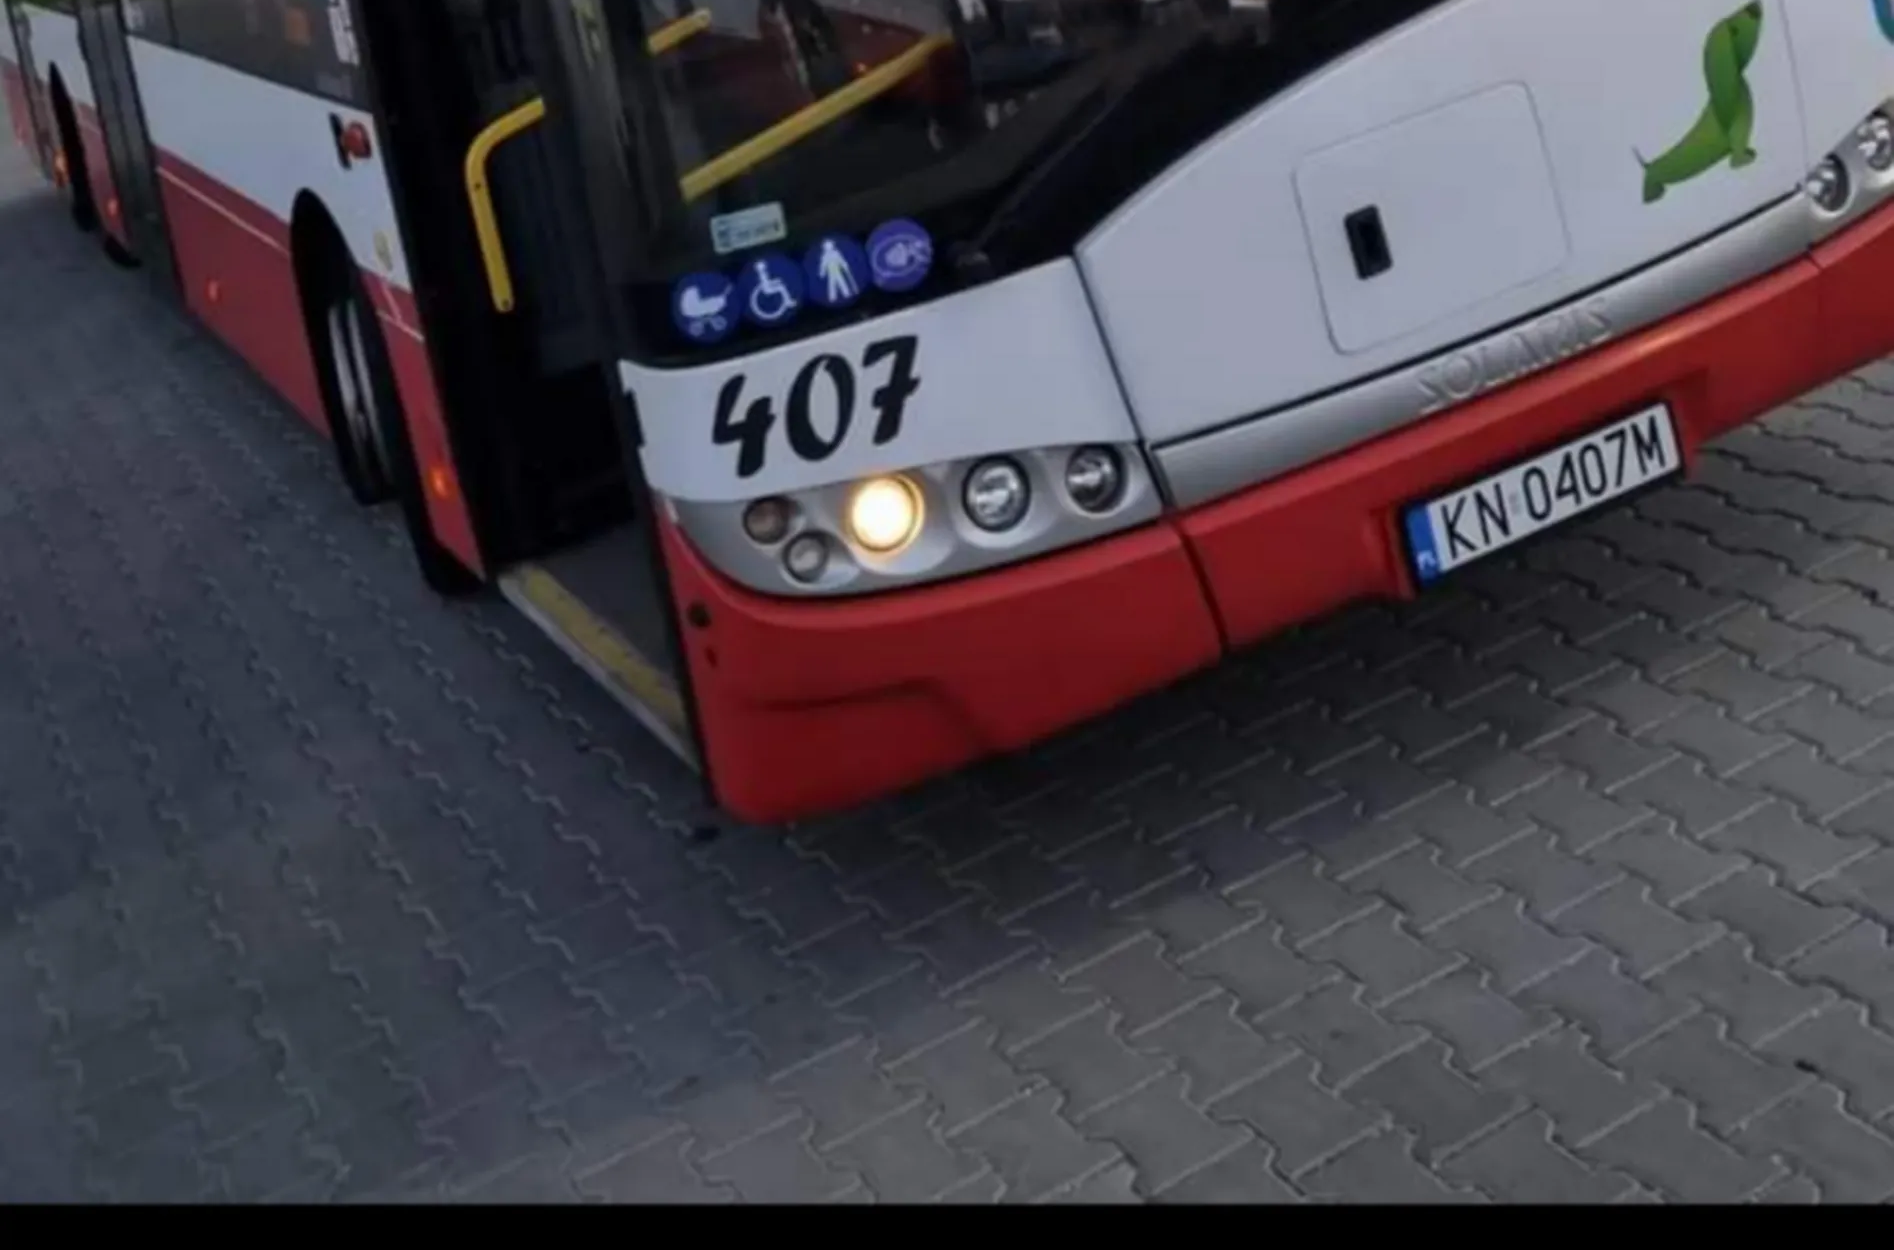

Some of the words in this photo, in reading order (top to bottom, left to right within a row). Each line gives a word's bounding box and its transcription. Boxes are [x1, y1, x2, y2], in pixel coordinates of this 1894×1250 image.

[711, 335, 921, 479] 407
[1440, 482, 1511, 560] KN
[1521, 415, 1667, 522] 0407M
